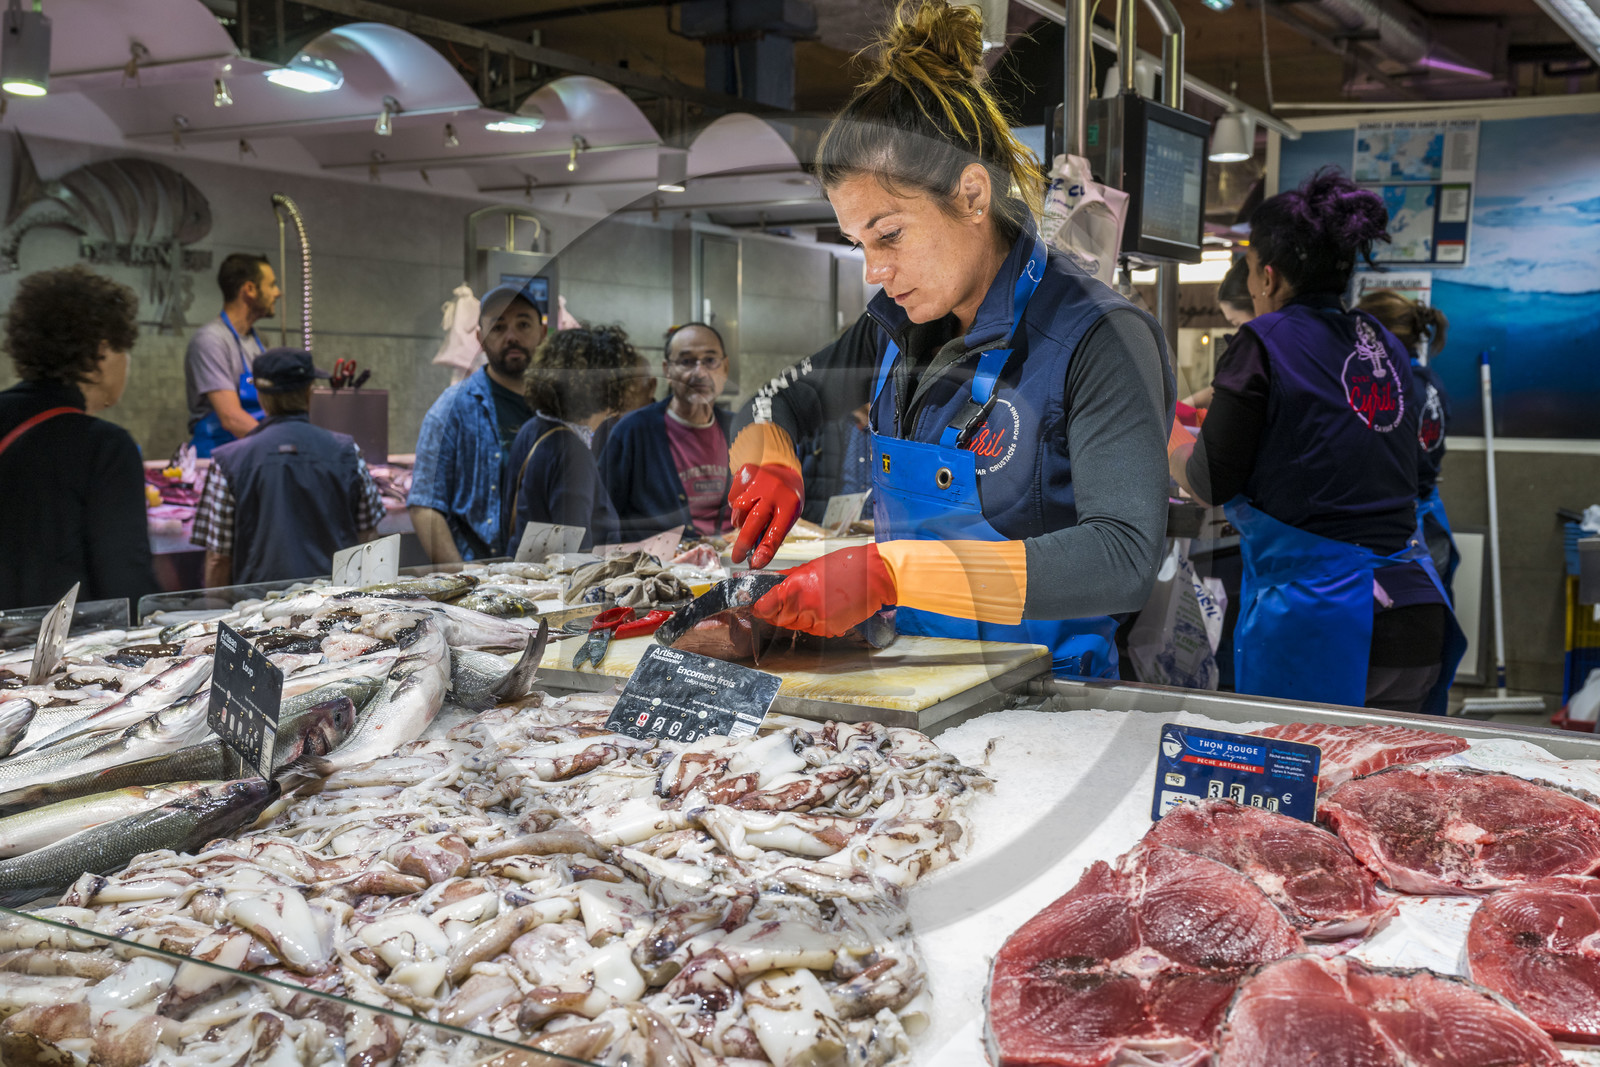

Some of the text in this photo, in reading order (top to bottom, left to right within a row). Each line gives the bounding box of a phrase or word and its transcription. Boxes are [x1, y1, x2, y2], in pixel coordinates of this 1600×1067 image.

[1350, 382, 1396, 429] Cyril
[1009, 406, 1021, 441] POISSONS
[989, 443, 1017, 473] CRUSTACÉS
[652, 647, 685, 661] Artisan
[242, 660, 254, 678] Loup
[716, 675, 737, 689] frais
[1199, 739, 1259, 756] THON ROUGE
[1222, 750, 1249, 763] ligne
[1219, 761, 1257, 772] ARTISANALE
